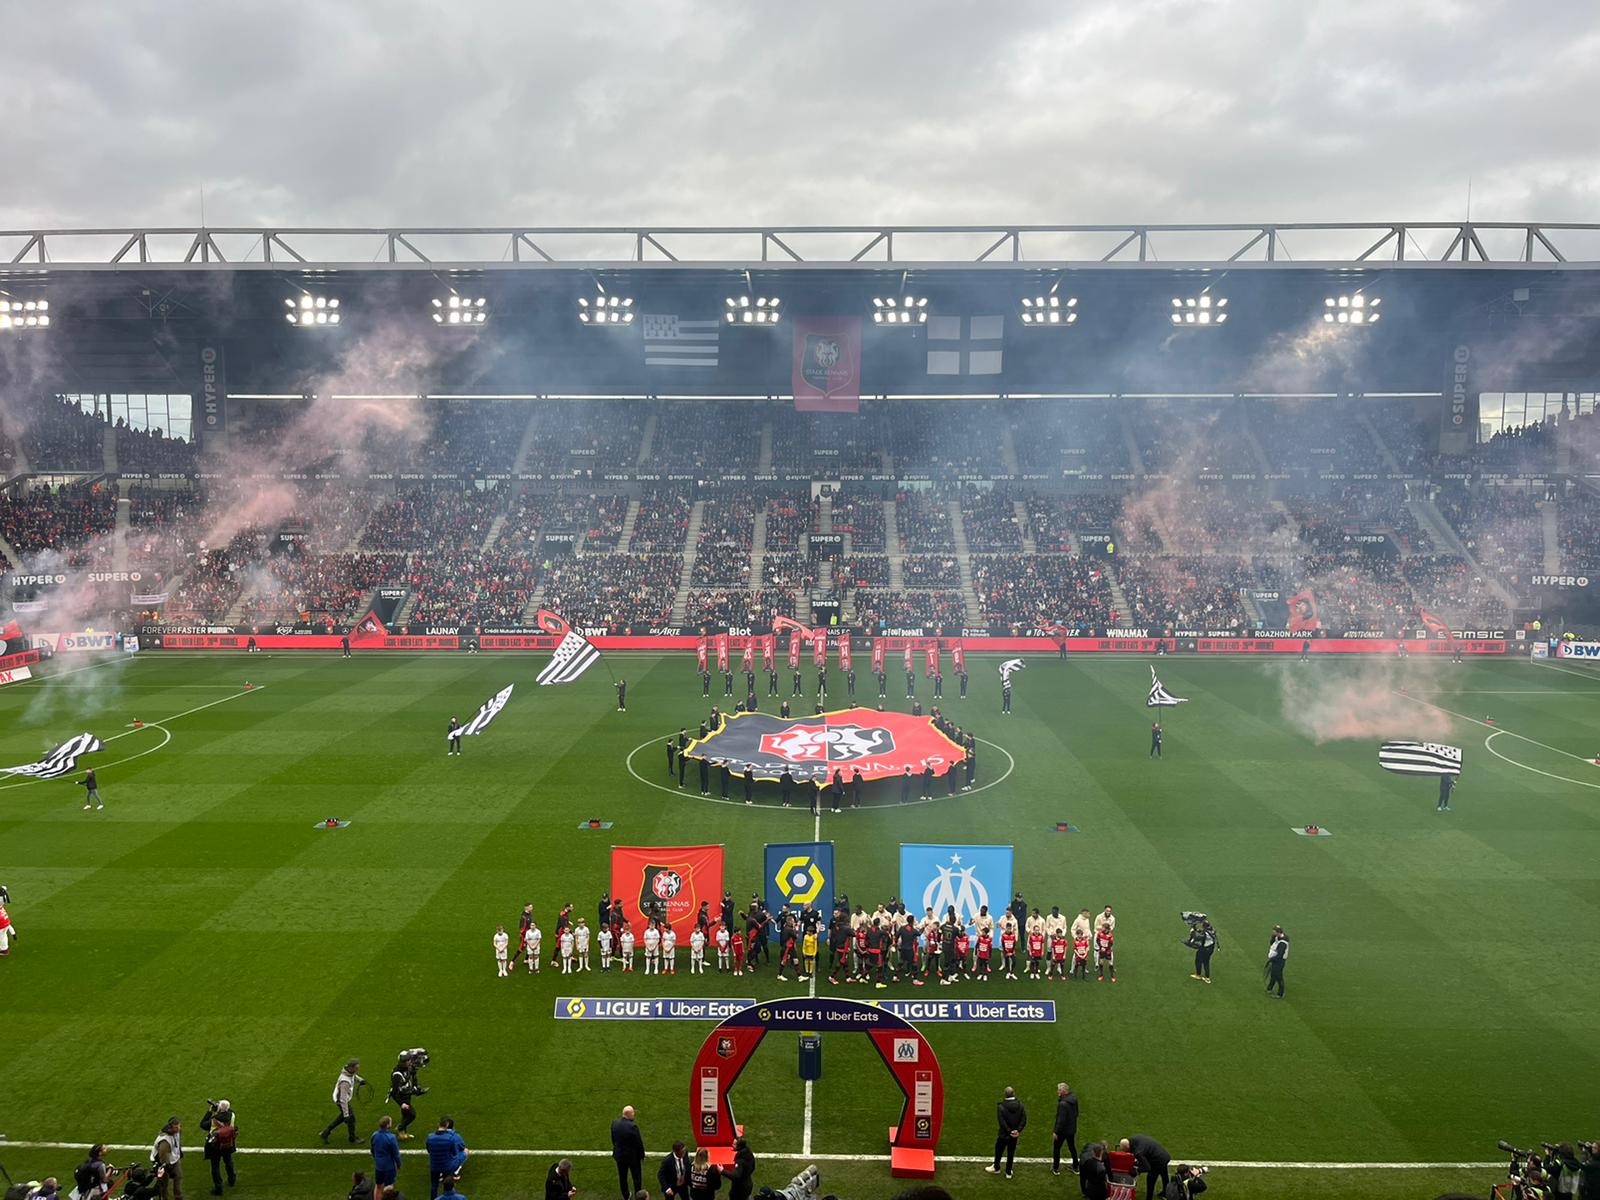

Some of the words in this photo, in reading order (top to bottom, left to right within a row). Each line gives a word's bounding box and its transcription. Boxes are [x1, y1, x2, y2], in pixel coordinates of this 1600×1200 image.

[203, 364, 217, 413] HYPER
[1452, 364, 1466, 413] SUPER
[12, 575, 53, 586] HYPER
[88, 573, 129, 582] SUPER
[1532, 576, 1575, 586] HYPER
[585, 628, 608, 636] BWT
[729, 627, 751, 636] Blot
[1106, 629, 1148, 637] WINAMAX
[76, 635, 113, 647] BWT
[595, 1002, 650, 1016] LIGUE
[655, 1002, 662, 1016] 1
[670, 1002, 705, 1017] Uber
[709, 1003, 744, 1017] Eats
[894, 1003, 949, 1017] LIGUE
[954, 1004, 962, 1017] 1
[969, 1004, 1004, 1018] Uber
[1008, 1004, 1044, 1018] Eats
[775, 1010, 812, 1020] LIGUE
[816, 1011, 822, 1020] 1
[826, 1011, 851, 1021] Uber
[853, 1012, 878, 1021] Eats
